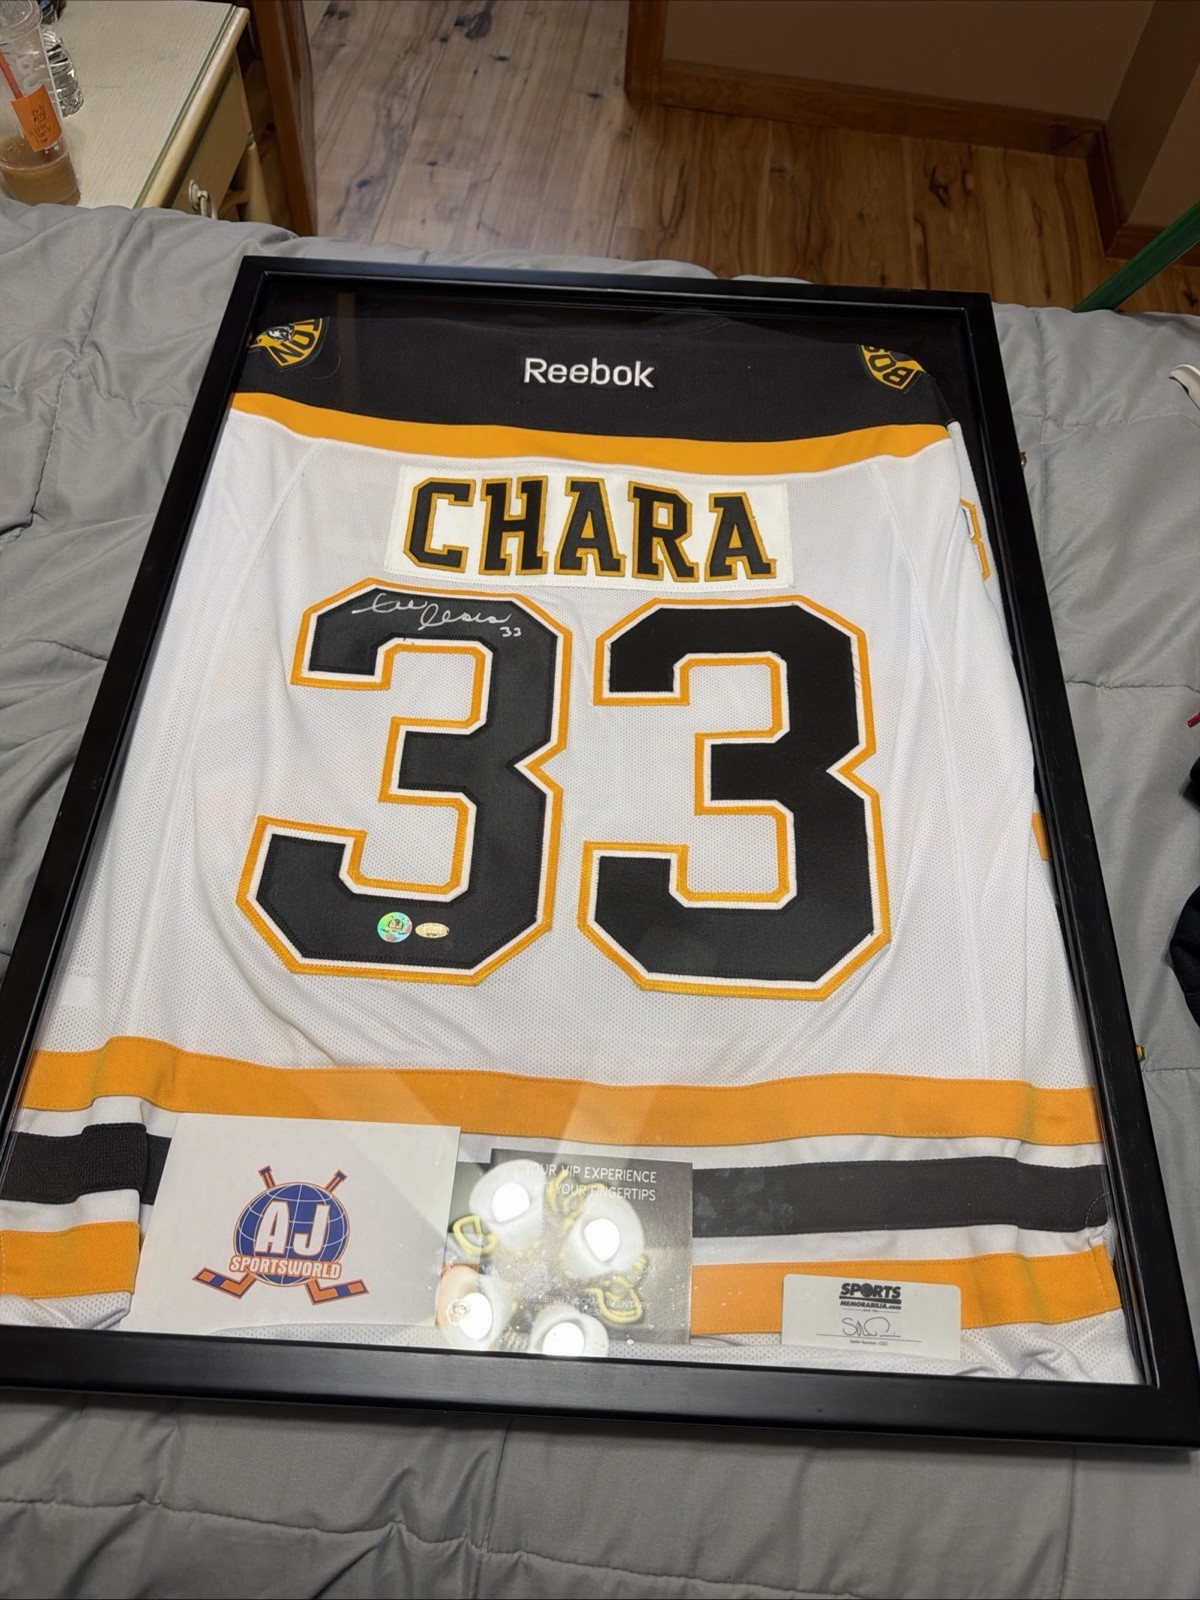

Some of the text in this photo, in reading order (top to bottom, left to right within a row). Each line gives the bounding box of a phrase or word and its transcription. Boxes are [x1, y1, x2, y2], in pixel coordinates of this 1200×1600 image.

[523, 356, 657, 390] Reebok
[402, 475, 777, 584] CHARA
[236, 578, 891, 1001] 33
[584, 1166, 658, 1184] EXPERIENCE
[556, 1182, 587, 1196] YOUR
[590, 1185, 657, 1202] FINGERTIPS
[254, 1200, 332, 1256] AJ
[229, 1256, 342, 1280] SPORTSWORLD
[840, 1282, 902, 1299] SPORTS
